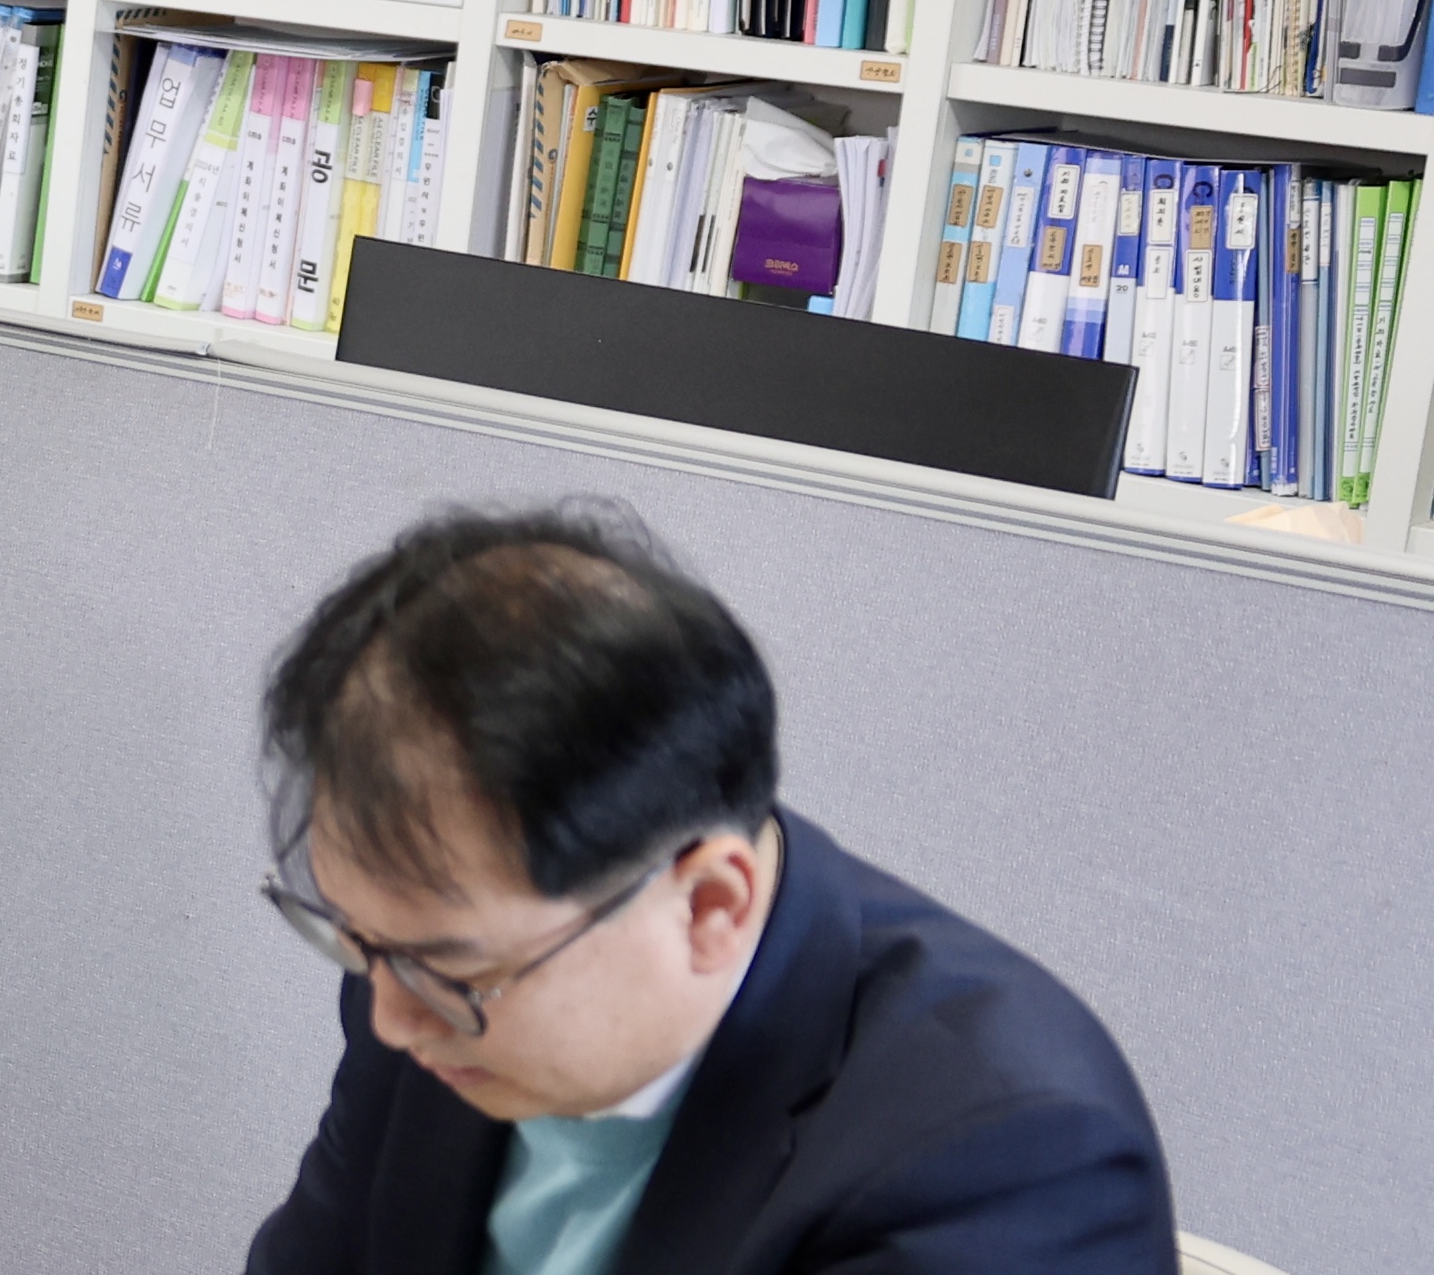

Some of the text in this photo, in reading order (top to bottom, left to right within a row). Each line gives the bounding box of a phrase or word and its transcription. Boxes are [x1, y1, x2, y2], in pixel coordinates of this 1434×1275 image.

[8, 57, 28, 162] 정기총회자료
[120, 77, 182, 234] 업무서류
[248, 130, 262, 141] cms
[281, 134, 297, 146] cms
[234, 160, 255, 264] 계좌이체신청서
[268, 165, 290, 270] 계좌이체신청서
